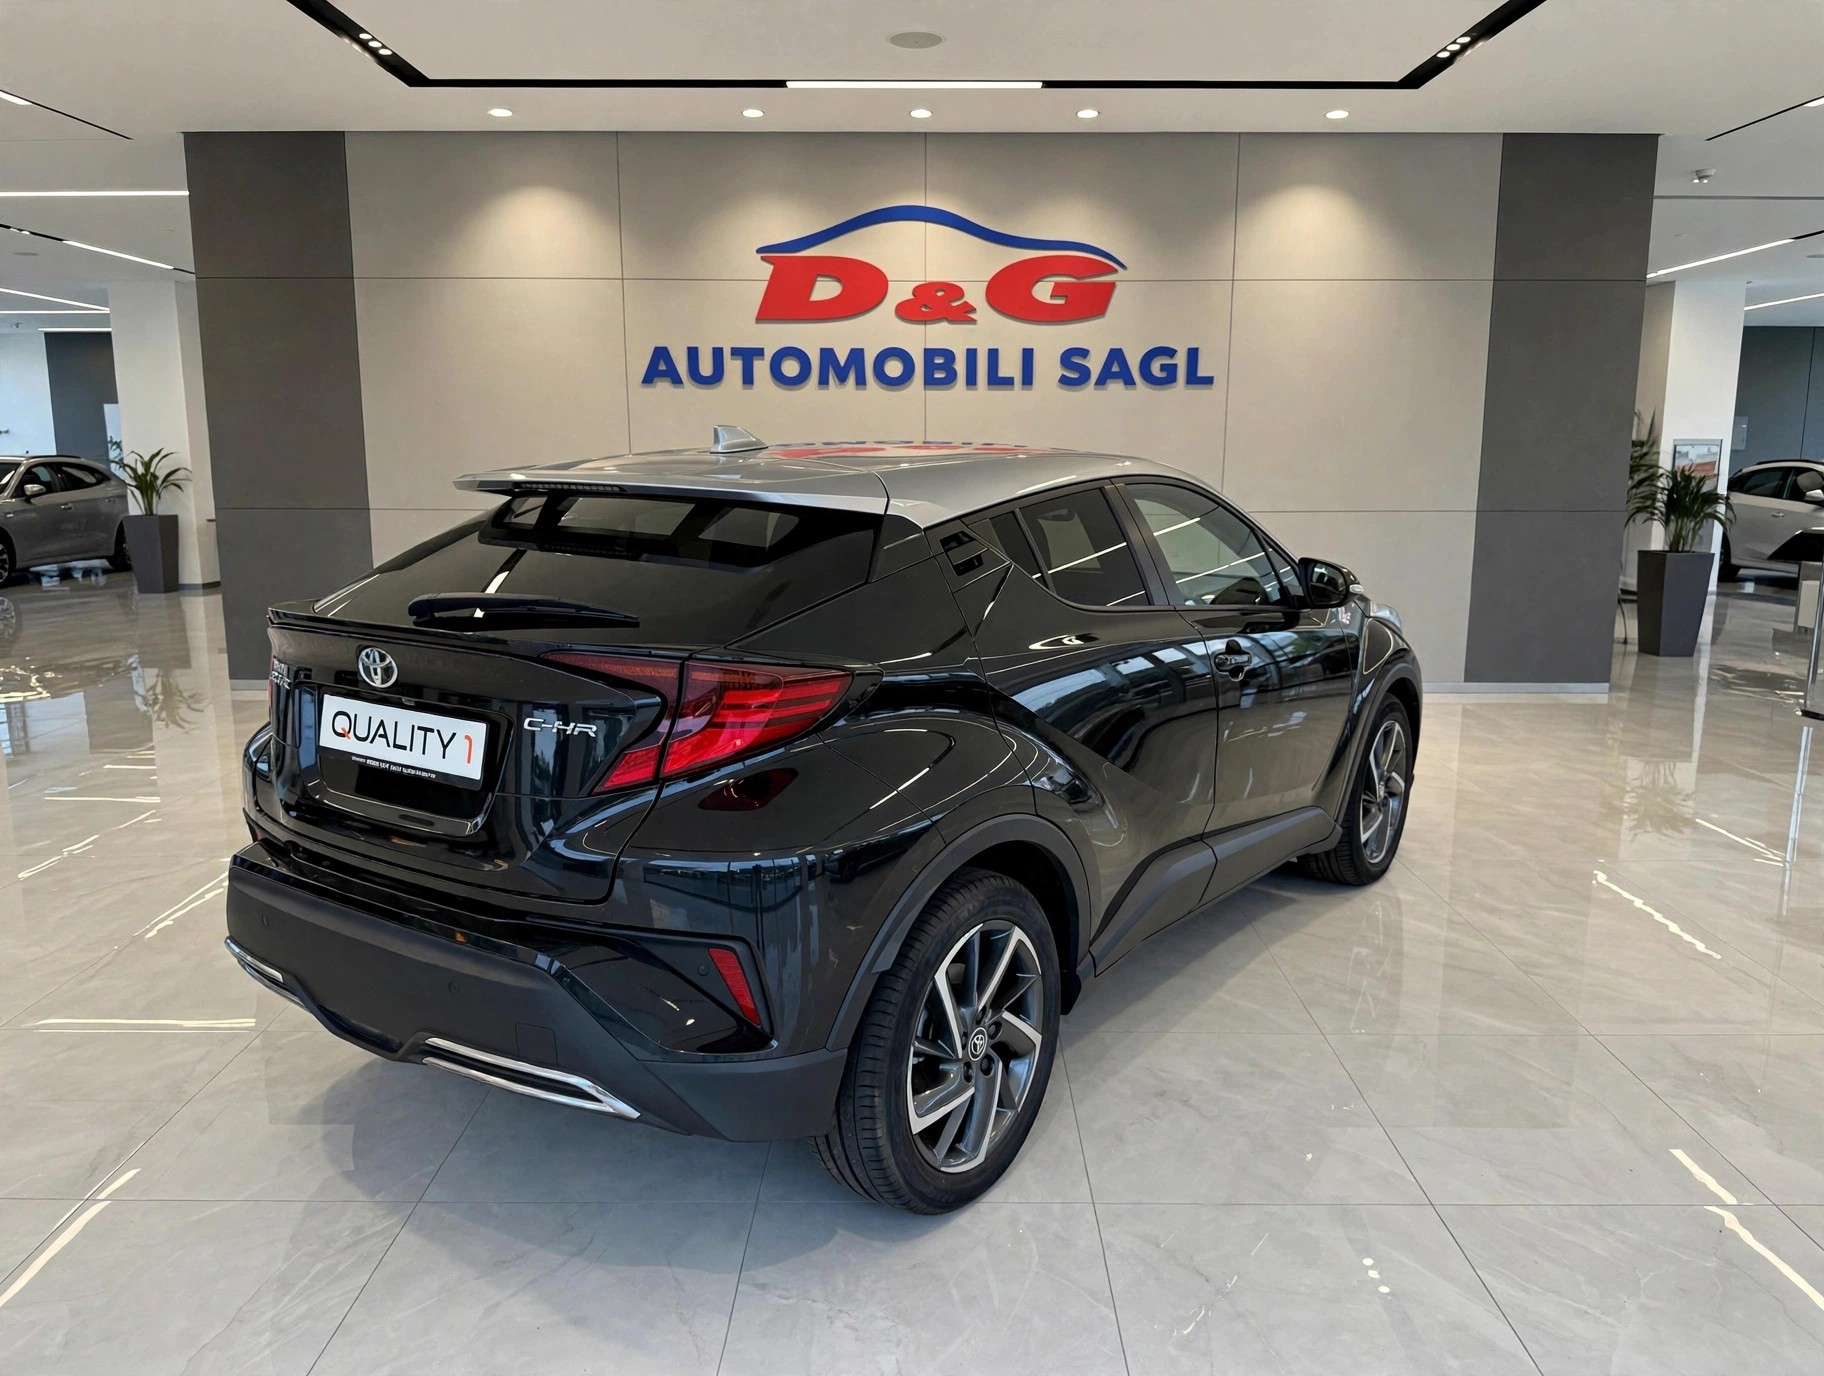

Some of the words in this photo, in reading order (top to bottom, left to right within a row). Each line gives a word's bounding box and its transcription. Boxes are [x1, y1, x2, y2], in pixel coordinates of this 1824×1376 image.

[755, 254, 1118, 322] D&G
[642, 346, 1034, 387] AUTOMOBILI
[1058, 346, 1215, 387] SAGL
[331, 709, 457, 760] QUALITY
[464, 734, 474, 764] 1
[523, 717, 598, 738] C-HR
